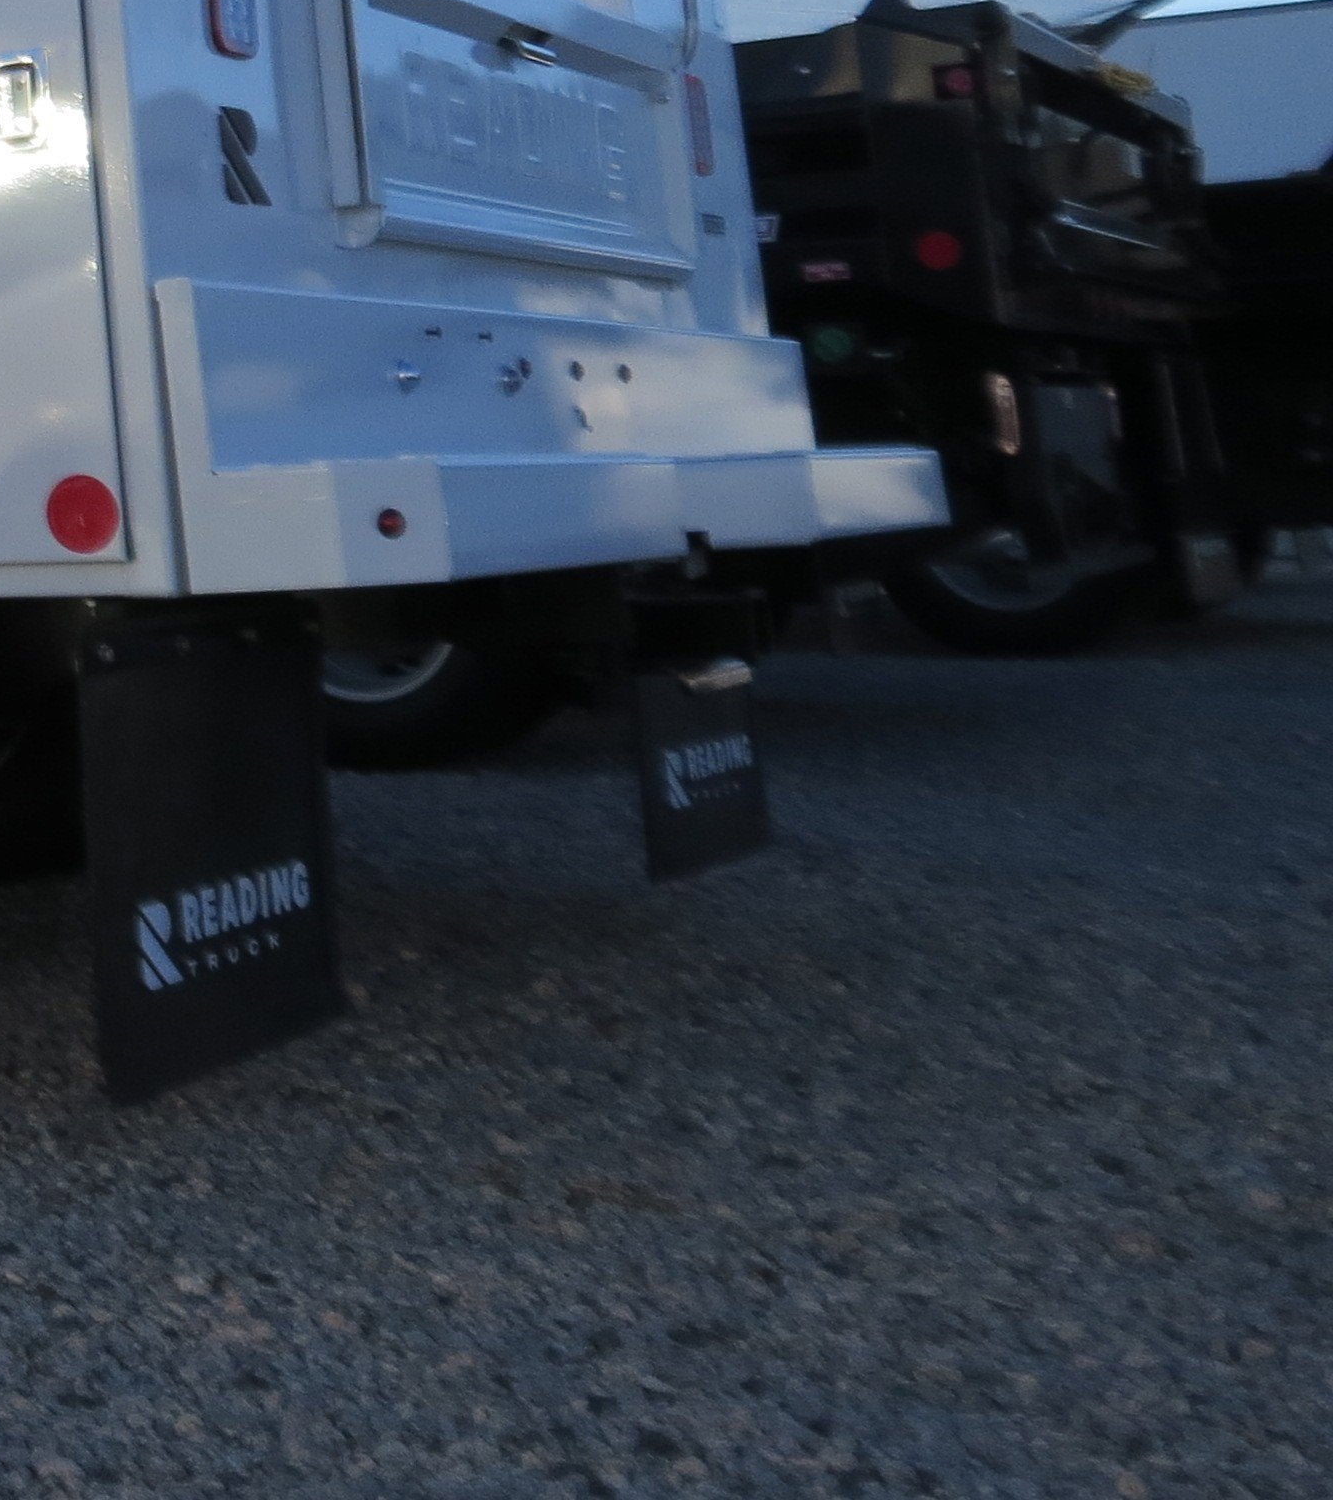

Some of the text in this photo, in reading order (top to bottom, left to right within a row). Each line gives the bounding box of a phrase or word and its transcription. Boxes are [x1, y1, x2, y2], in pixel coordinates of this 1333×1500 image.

[686, 733, 752, 781] READING
[180, 861, 311, 944] READING
[185, 932, 281, 978] TRUCK
